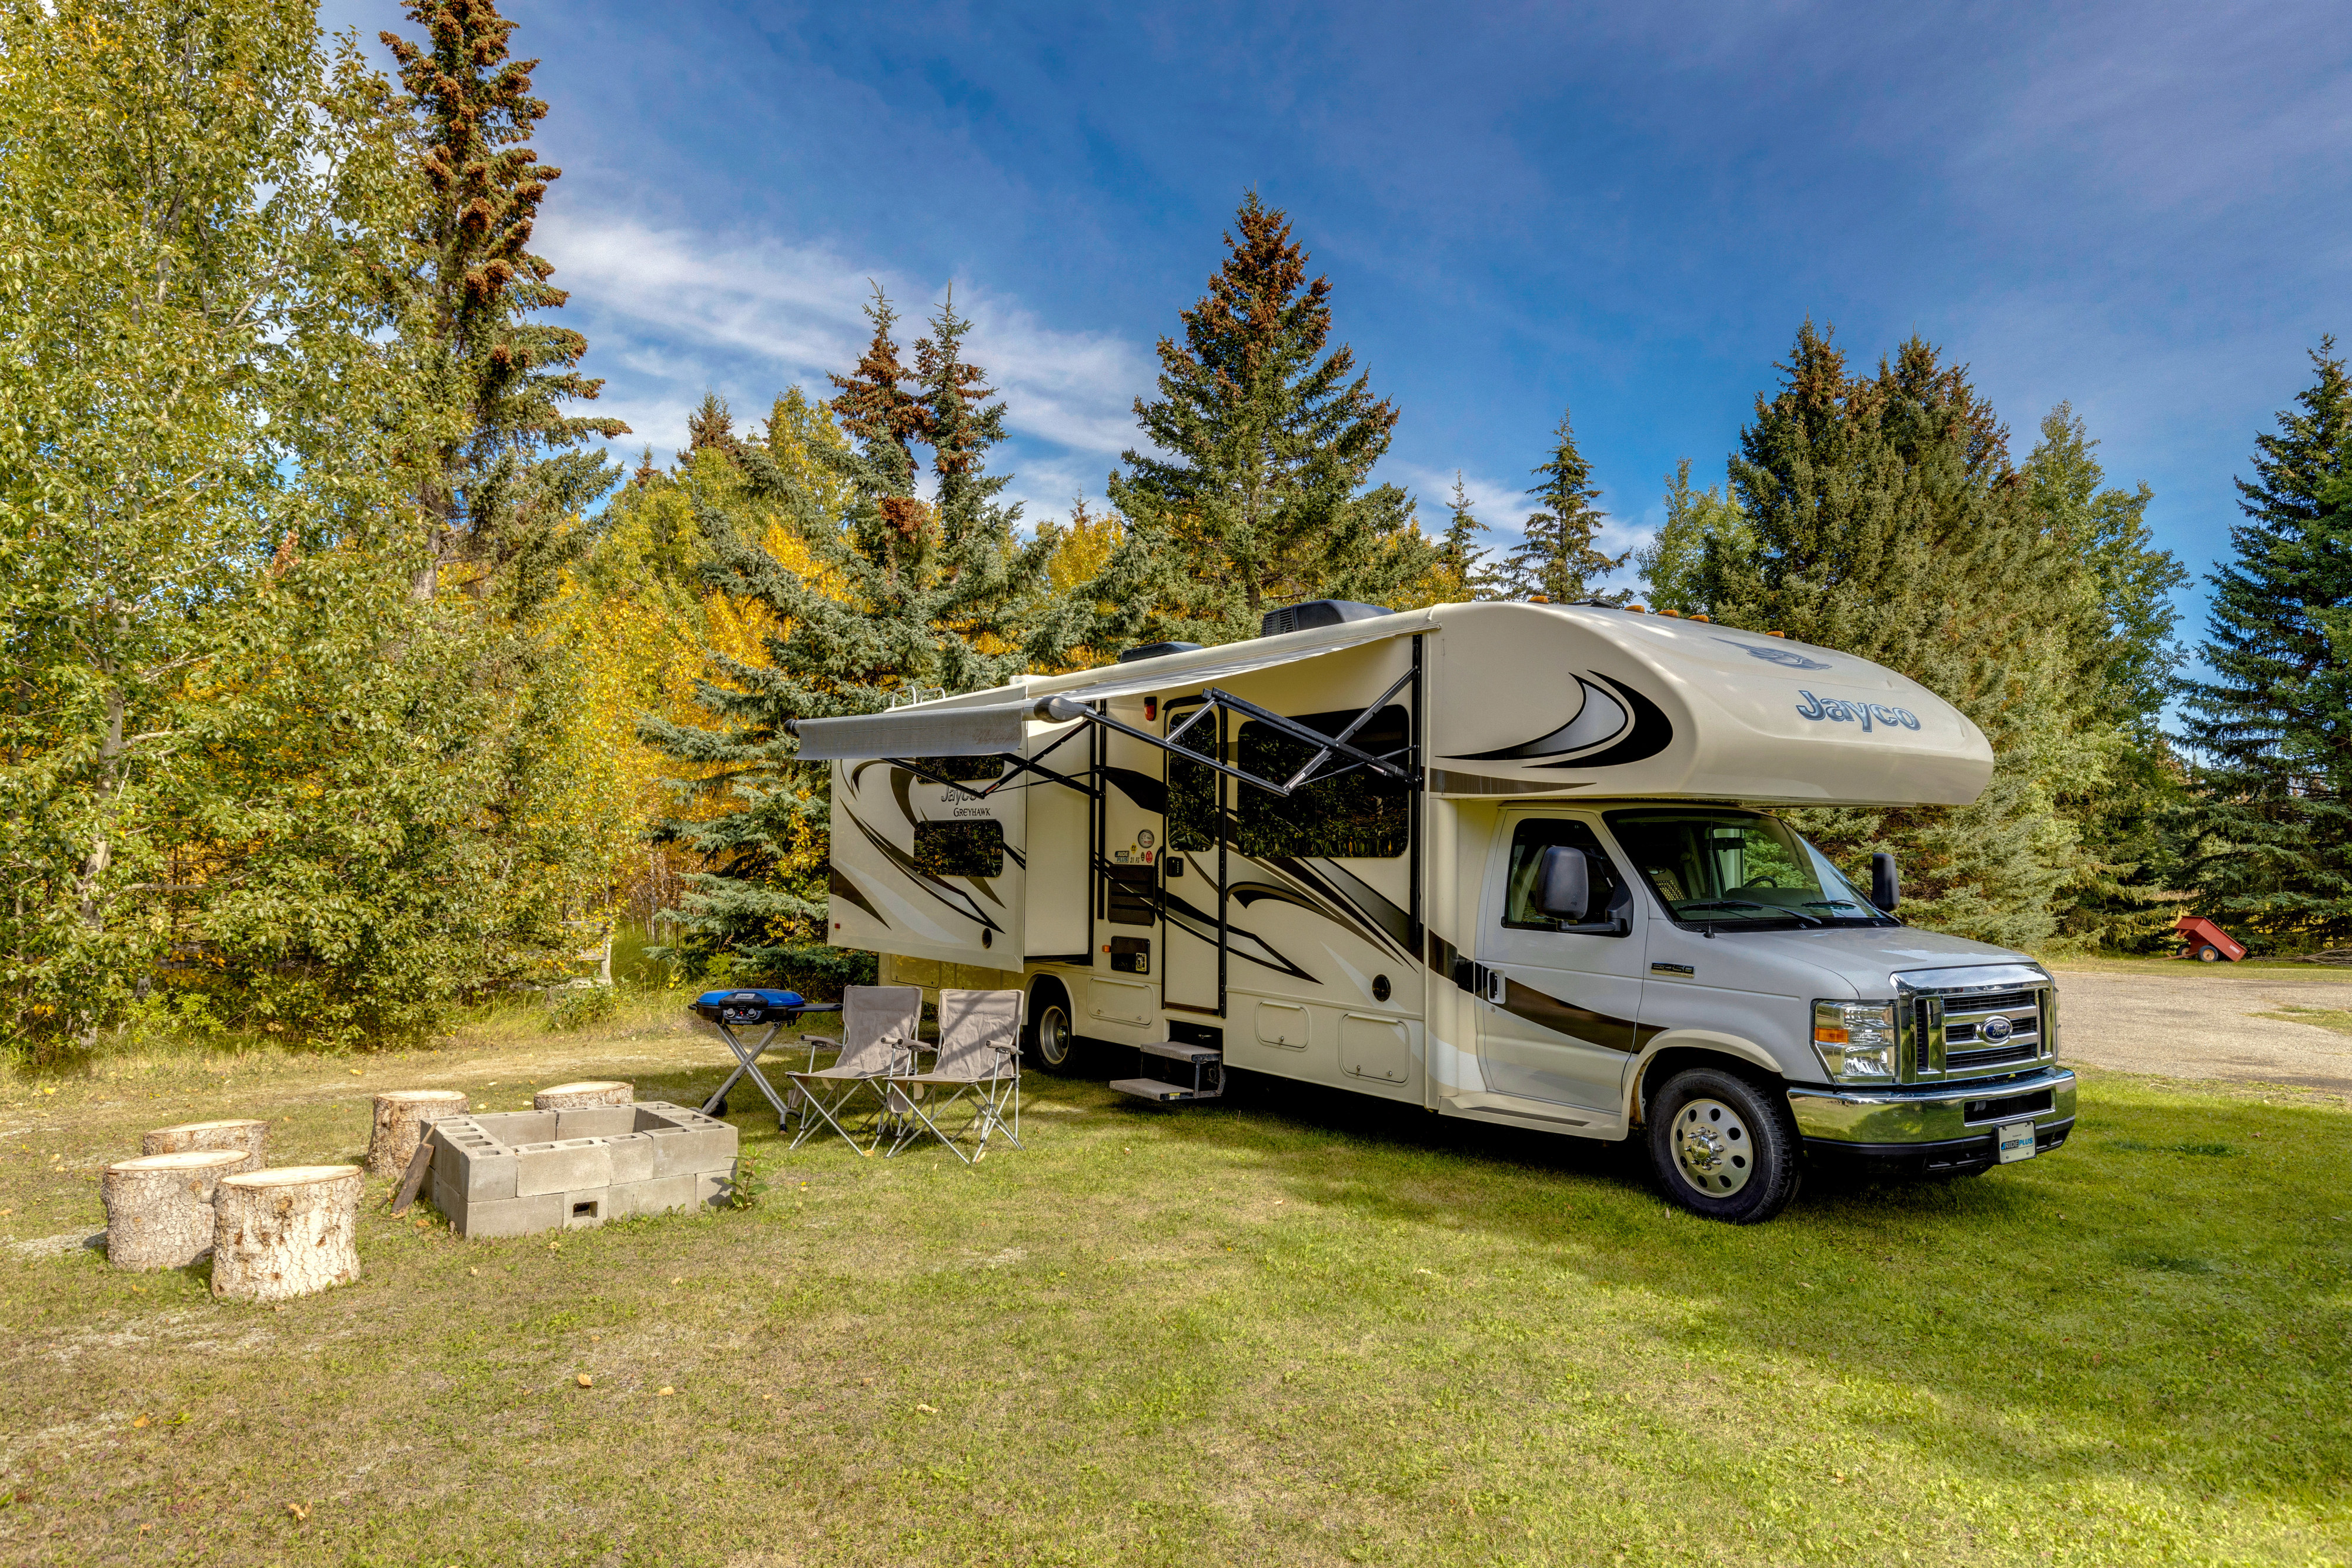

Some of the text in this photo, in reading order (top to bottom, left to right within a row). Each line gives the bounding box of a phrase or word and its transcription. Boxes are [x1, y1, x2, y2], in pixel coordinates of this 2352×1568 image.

[1796, 690, 1921, 733] Jayco
[953, 807, 991, 817] GREYHAWK
[1993, 1024, 2007, 1036] Ford
